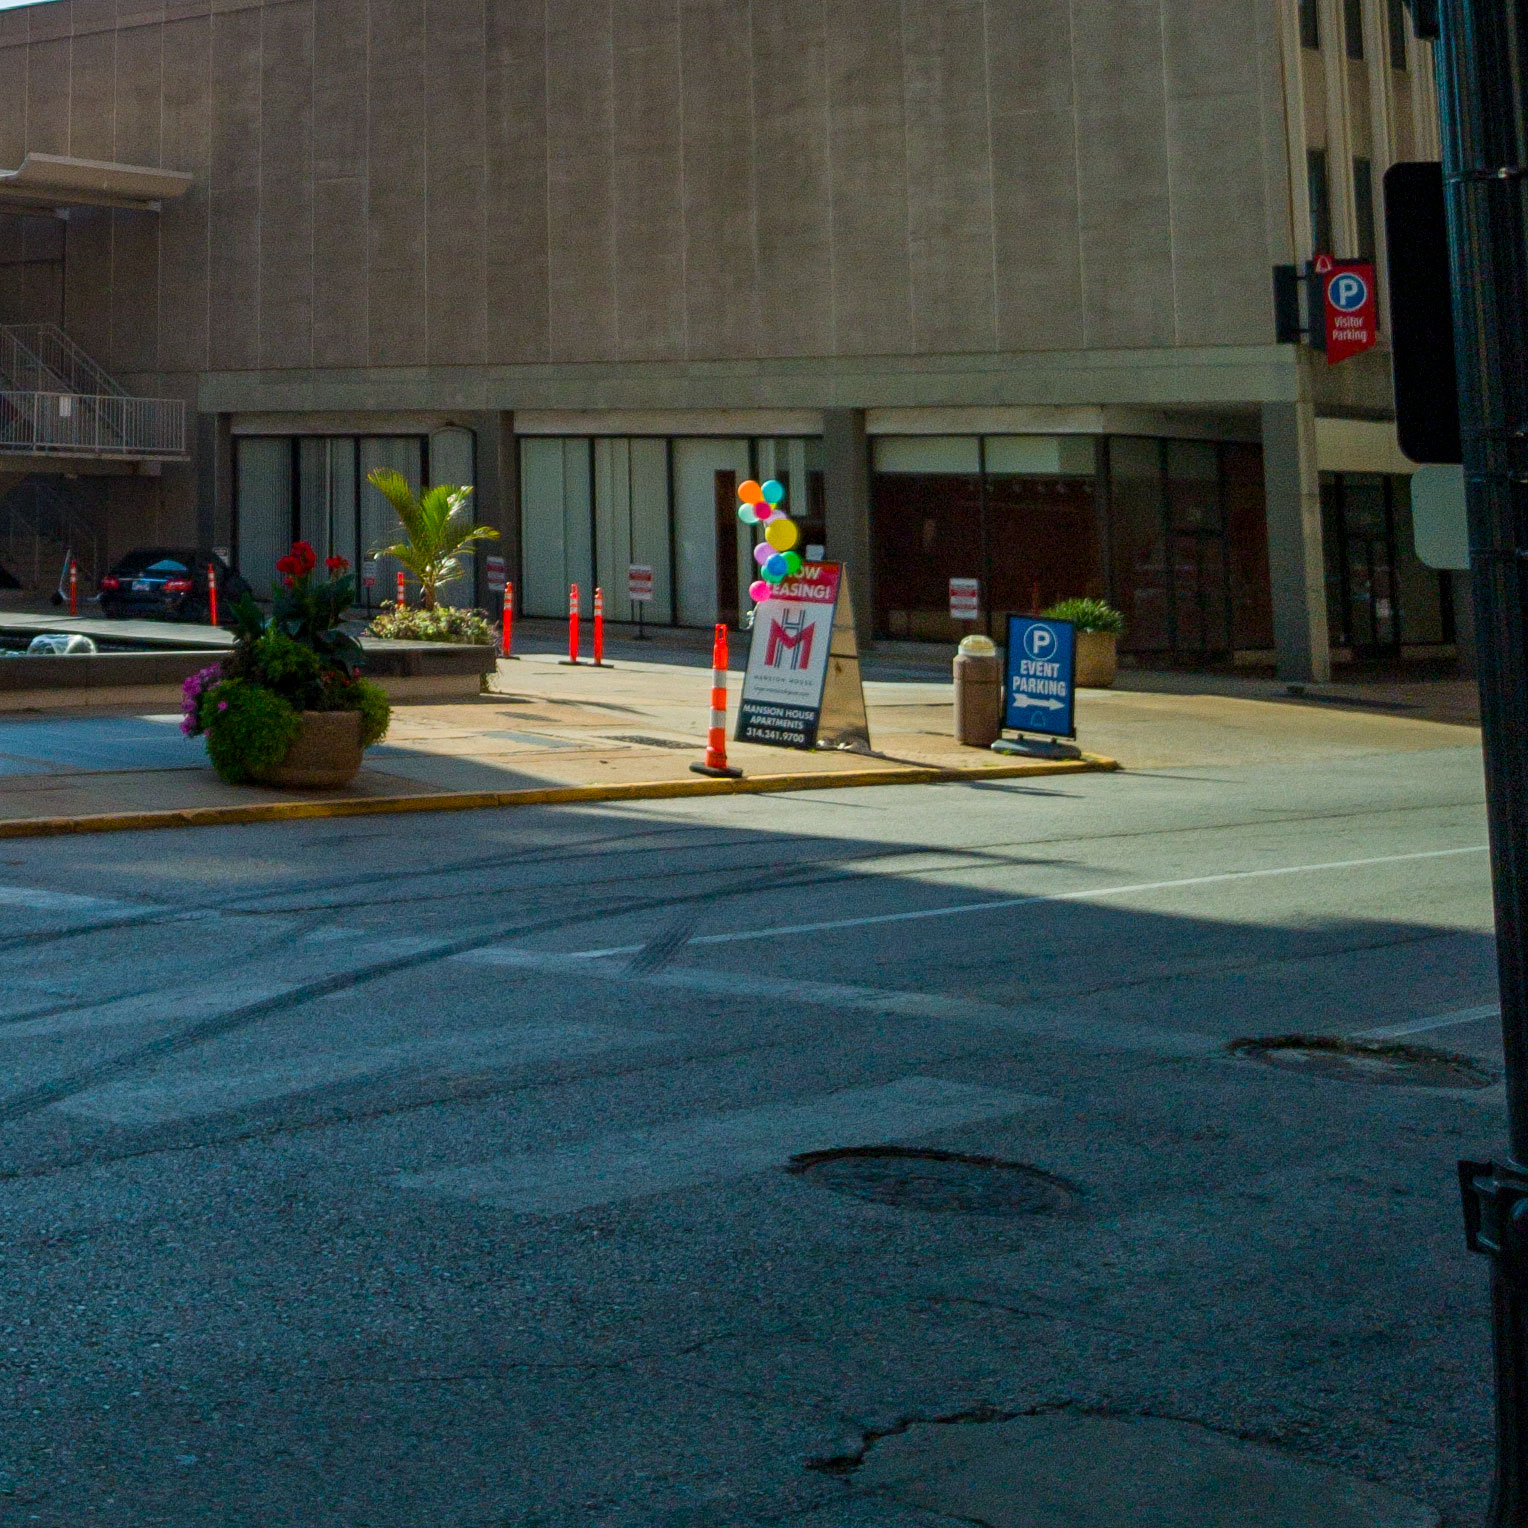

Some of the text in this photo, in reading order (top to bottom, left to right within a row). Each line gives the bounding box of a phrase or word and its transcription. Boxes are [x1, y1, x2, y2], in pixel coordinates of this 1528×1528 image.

[1338, 278, 1359, 306] P
[1334, 315, 1364, 328] Visitor
[1332, 330, 1367, 343] Parking
[788, 566, 822, 580] OW
[770, 582, 831, 600] EASING!
[1033, 629, 1050, 654] P
[1020, 659, 1060, 678] EVENT
[1012, 675, 1067, 697] PARKING
[743, 703, 815, 721] MANSION HOUSE
[750, 715, 804, 730] APARTMENTS
[746, 726, 805, 743] 314.241.9700
